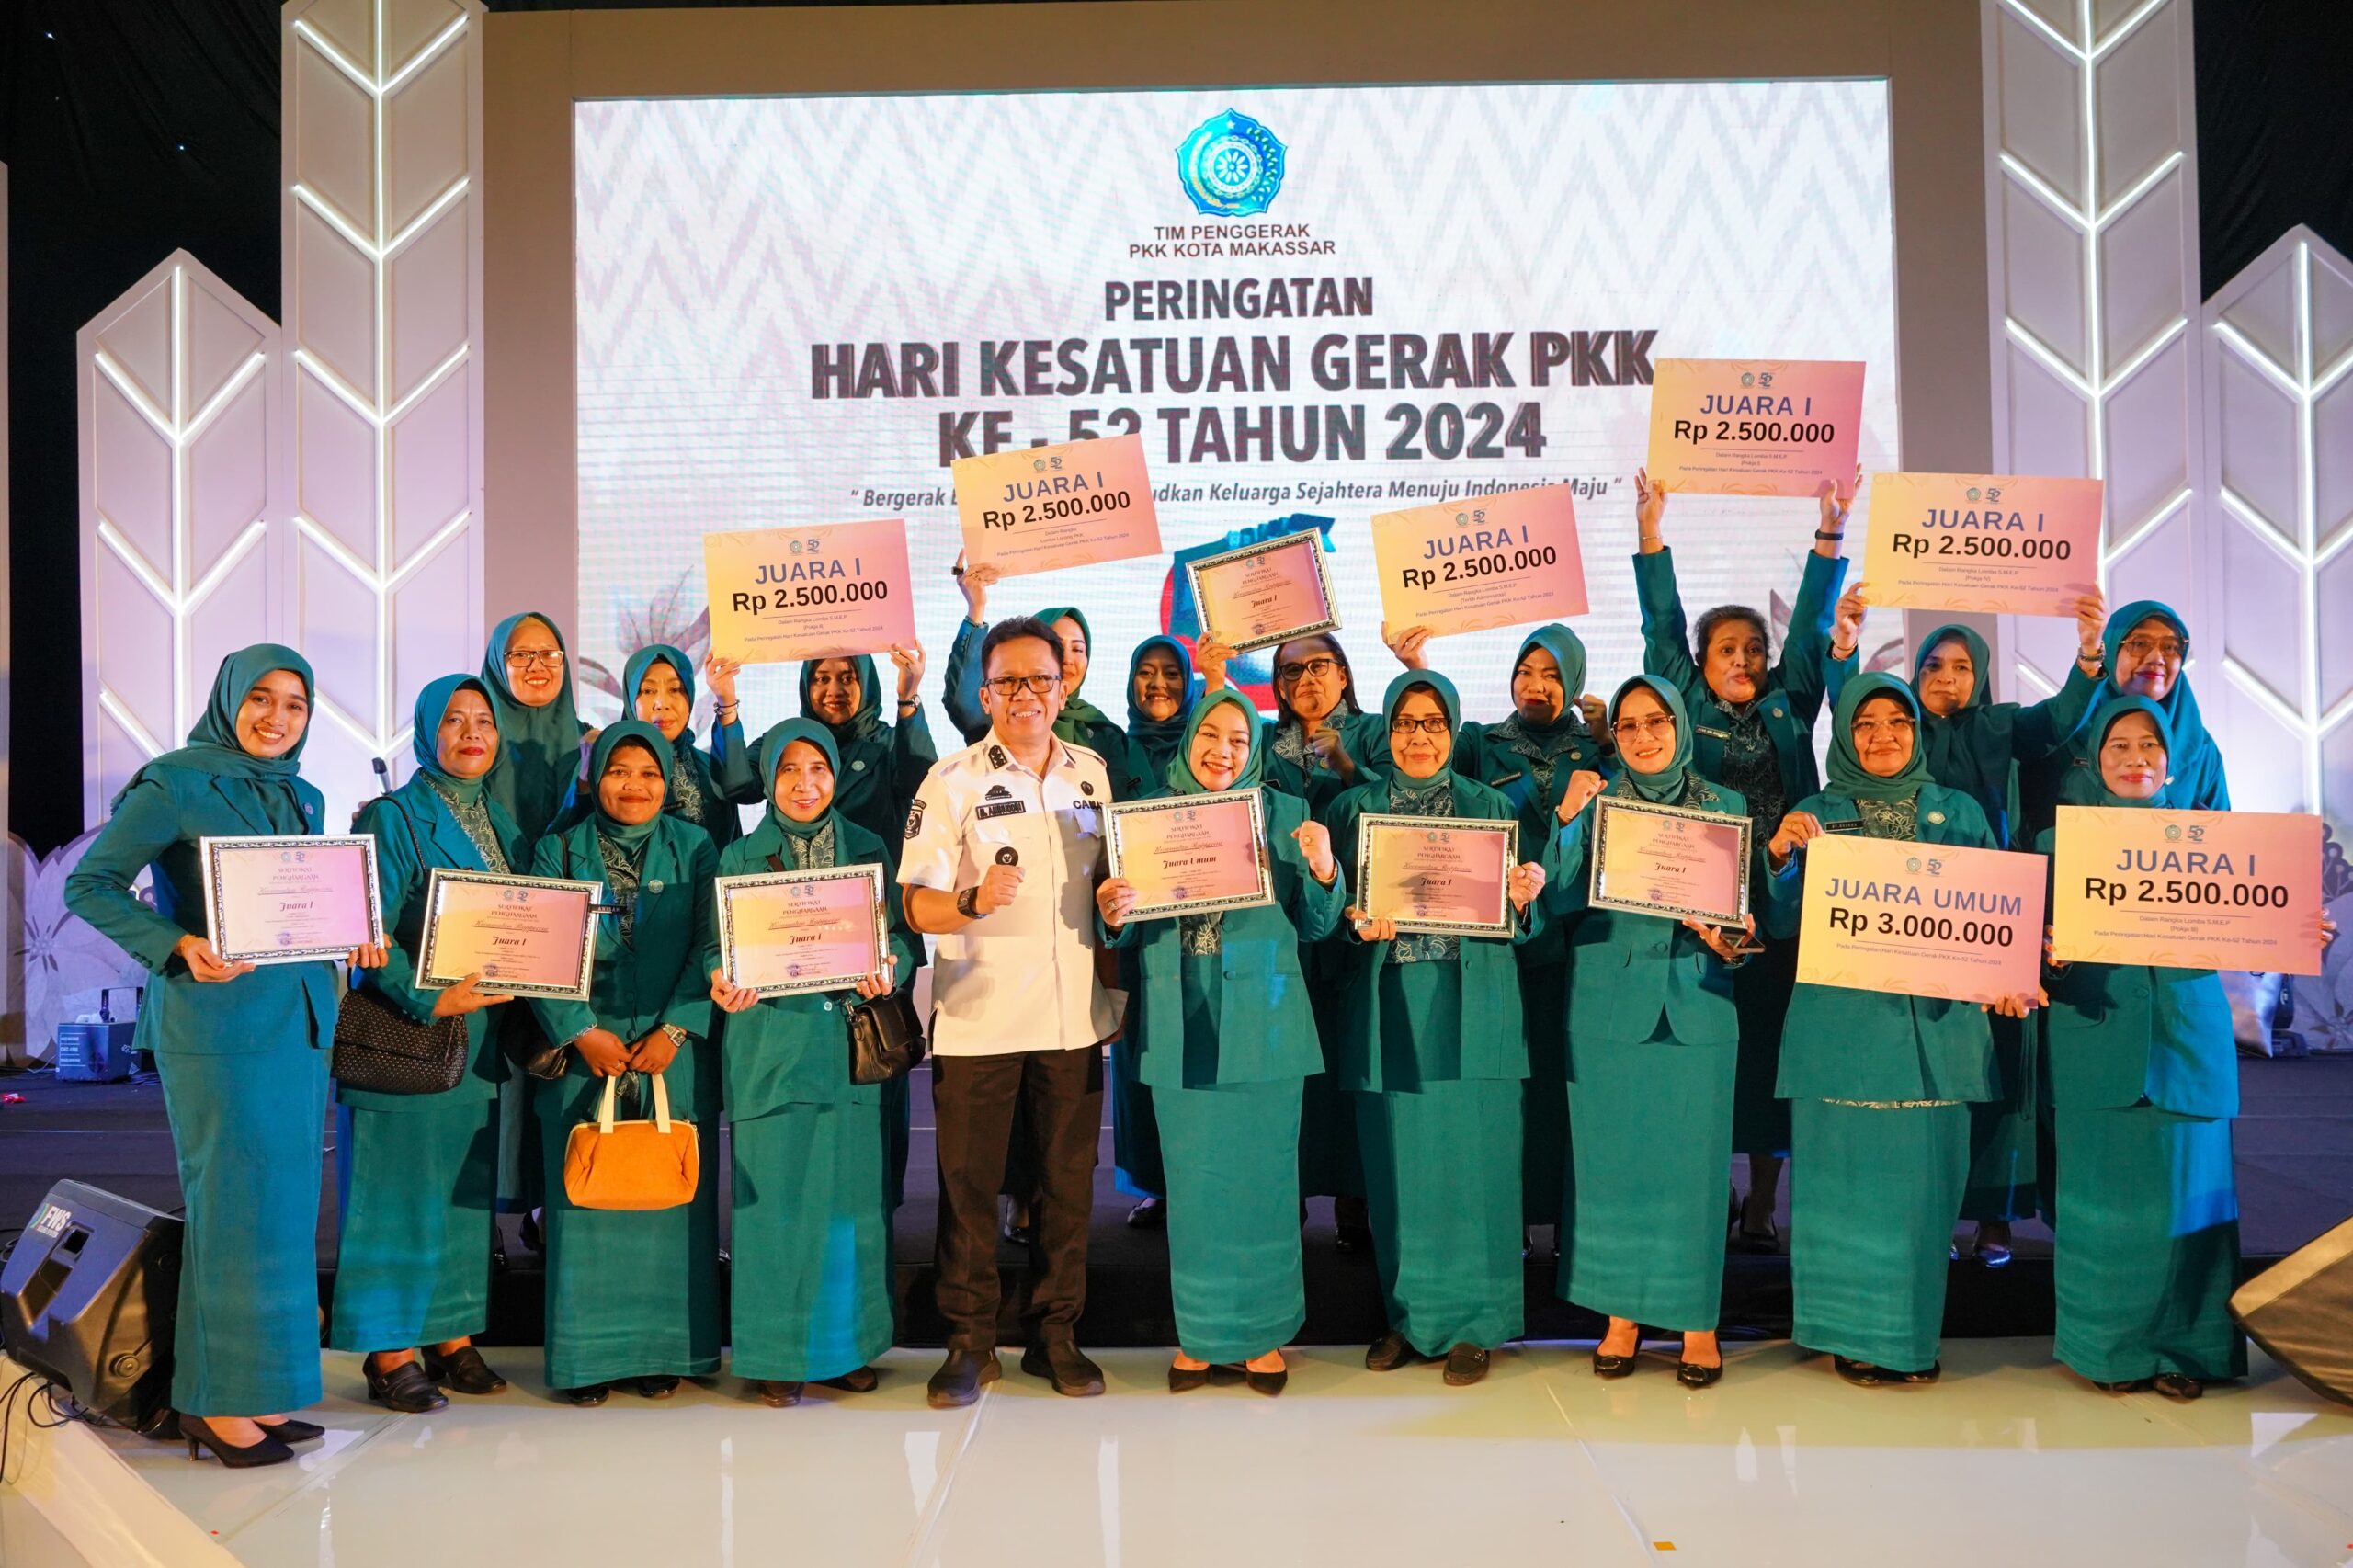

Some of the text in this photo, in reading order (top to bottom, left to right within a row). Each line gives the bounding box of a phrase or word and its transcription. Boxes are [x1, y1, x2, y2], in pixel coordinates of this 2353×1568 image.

[1154, 224, 1310, 240] TIM PENGGERAK
[1130, 241, 1335, 257] PKK KOTA MAKASSAR
[1105, 277, 1372, 321] PERINGATAN
[811, 329, 1658, 399] HARI KESATUAN GERAK PKK
[1700, 395, 1811, 415] JUARA I
[1157, 405, 1365, 462] TAHUN
[1386, 402, 1547, 460] 2024
[1675, 420, 1835, 444] Rp 2.500.000
[863, 487, 946, 510] Bergerak
[1210, 482, 1290, 505] Keluarga
[1297, 480, 1382, 505] Sejahtera
[1389, 478, 1459, 503] Menuju
[1004, 472, 1103, 503] JUARA I
[983, 491, 1131, 530] Rp 2.500.000
[1922, 509, 2043, 532] JUARA I
[1423, 525, 1529, 559] JUARA I
[1893, 533, 2071, 560] Rp 2.500.000
[756, 558, 860, 585] JUARA I
[1402, 546, 1556, 589] Rp 2.500.000
[733, 581, 888, 615] Rp 2.500.000
[1251, 598, 1272, 608] Juara
[1074, 800, 1103, 811] CAMA
[1164, 860, 1188, 869] Juara
[1654, 863, 1680, 872] Juara
[2116, 849, 2255, 876] JUARA I
[1421, 878, 1447, 886] Juara
[2086, 877, 2289, 908] Rp 2.500.000
[280, 903, 307, 911] Juara
[1825, 879, 2021, 916] JUARA UMUM
[790, 935, 816, 944] Juara
[1829, 907, 2013, 947] Rp 3.000.000
[493, 937, 519, 946] Juara
